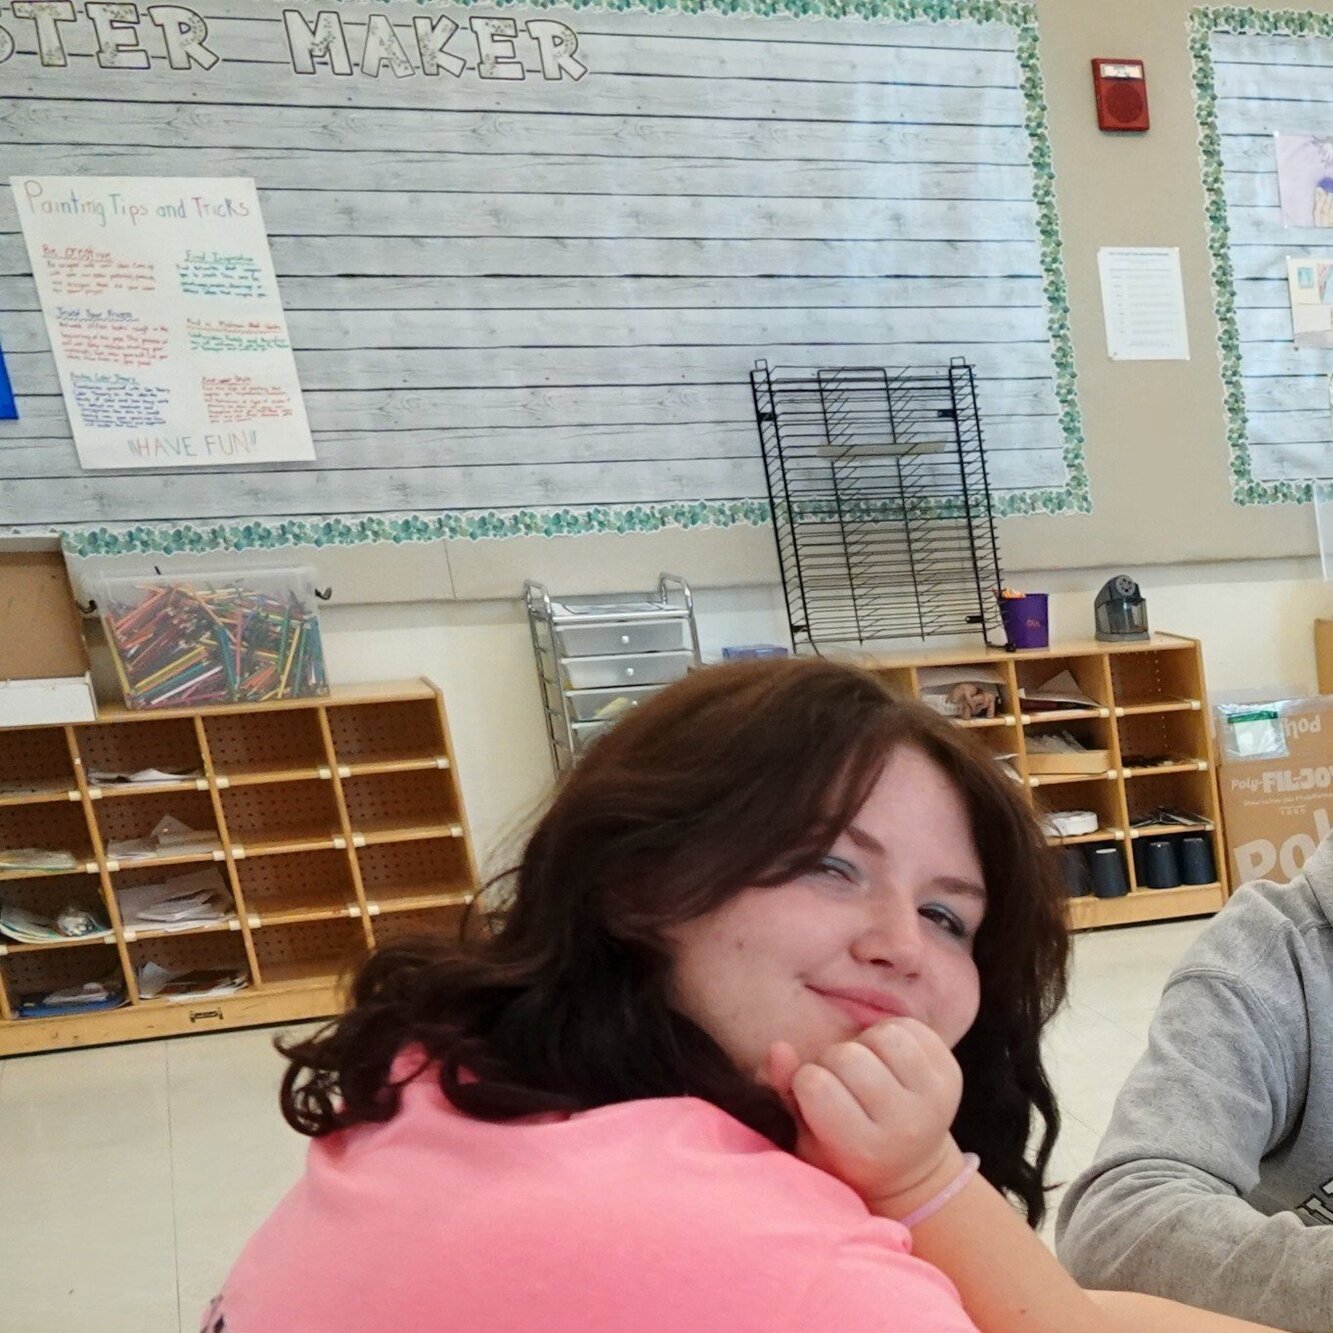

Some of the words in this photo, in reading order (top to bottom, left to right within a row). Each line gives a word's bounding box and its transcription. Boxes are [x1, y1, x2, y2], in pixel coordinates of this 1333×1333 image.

[0, 0, 219, 70] TER
[282, 9, 588, 81] MAKER
[24, 180, 106, 226] Painting
[110, 193, 147, 225] Tips
[157, 201, 186, 218] and
[192, 197, 250, 217] Tricks
